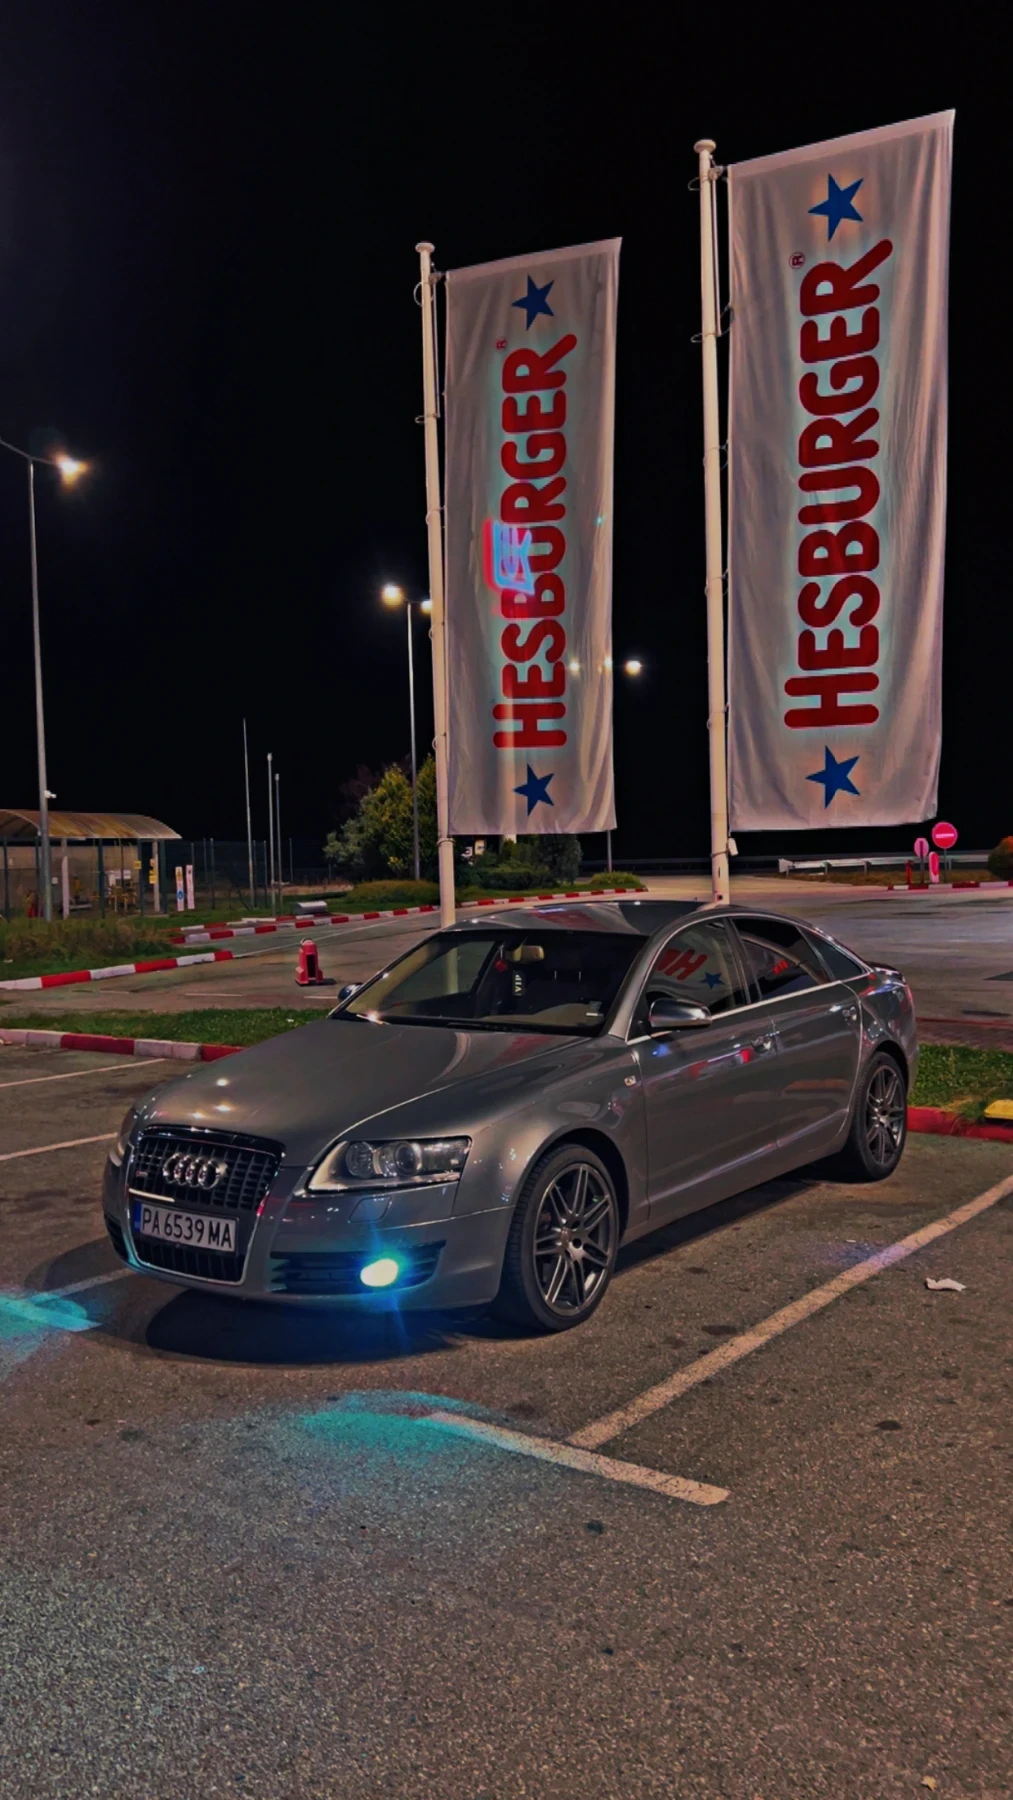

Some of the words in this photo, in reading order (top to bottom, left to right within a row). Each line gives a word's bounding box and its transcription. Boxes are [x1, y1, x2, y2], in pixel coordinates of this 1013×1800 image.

[493, 334, 578, 749] HESBURGER
[784, 239, 893, 728] HESBURGER
[514, 974, 522, 993] VIP
